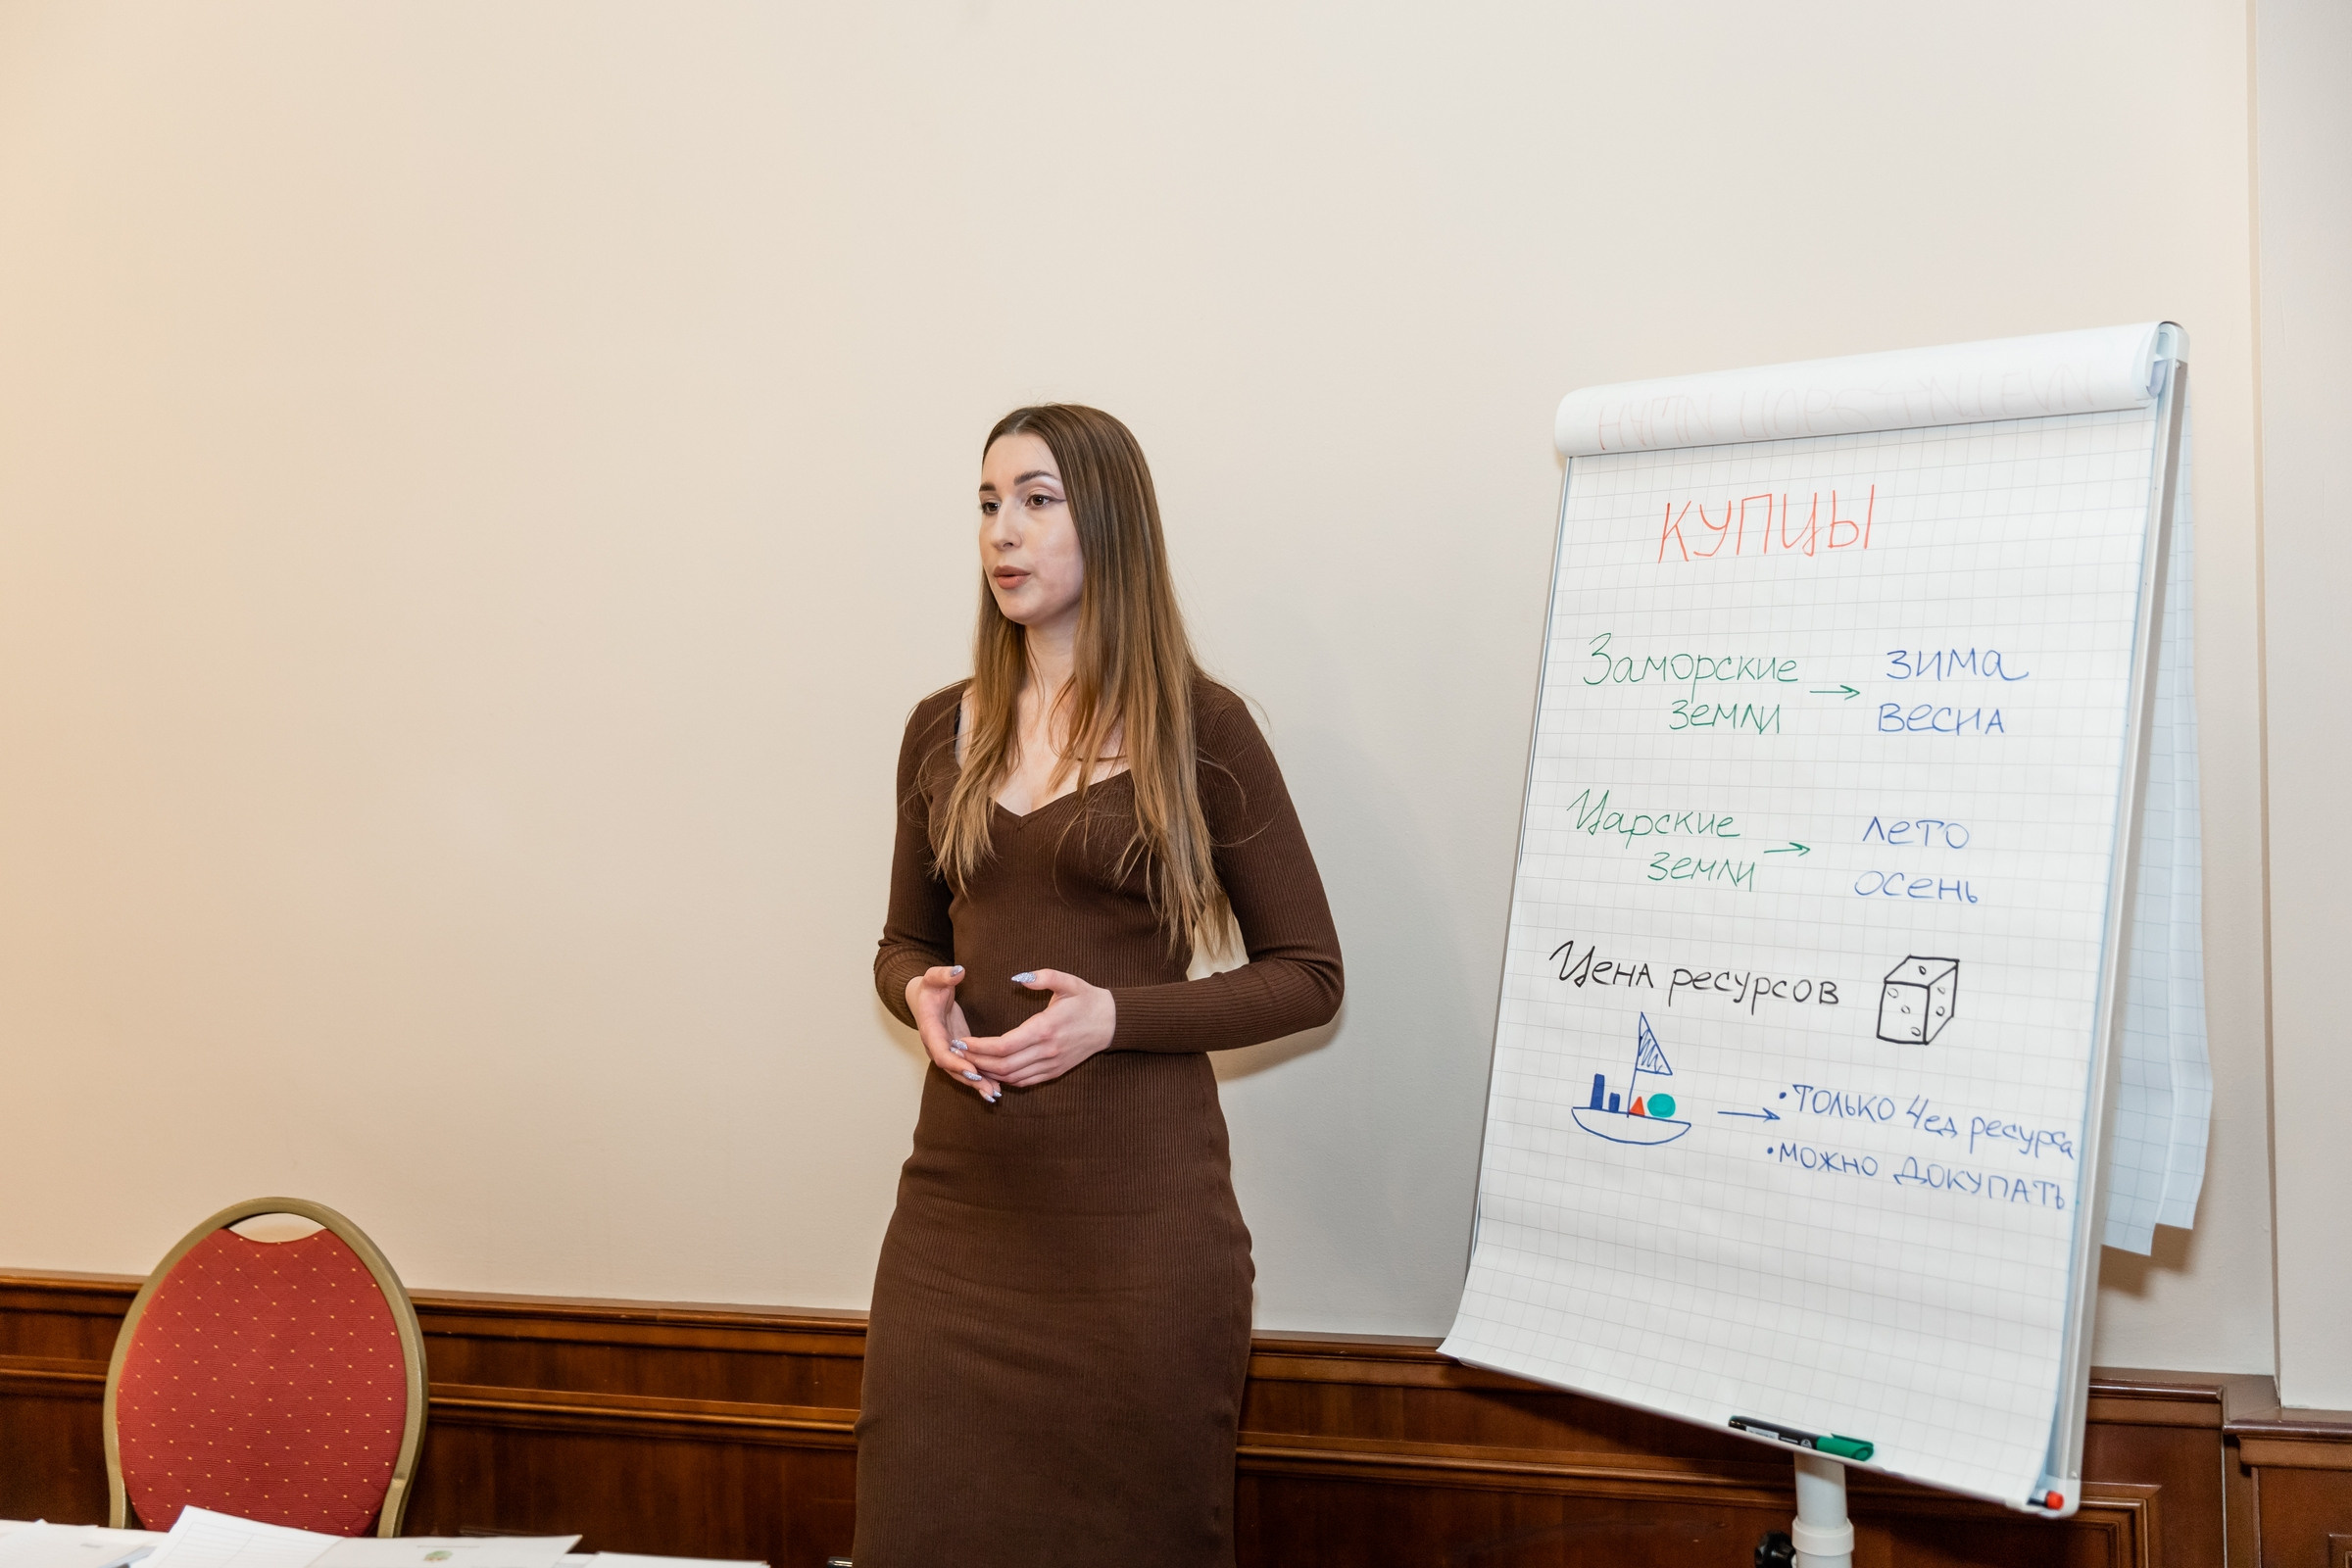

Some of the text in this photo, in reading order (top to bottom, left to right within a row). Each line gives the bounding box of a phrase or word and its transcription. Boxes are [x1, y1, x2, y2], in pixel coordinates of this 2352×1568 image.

[1658, 484, 1875, 564] КУПЦЫ
[1583, 632, 1799, 702] Заморские
[1669, 699, 1781, 735] земли
[1567, 788, 1741, 849] Царские
[1647, 852, 1756, 893] земли
[1549, 940, 1839, 1016] Цена ресурсов
[1969, 1116, 2076, 1160] ресурса
[1892, 1155, 2066, 1210] ДОКУПАТЬ
